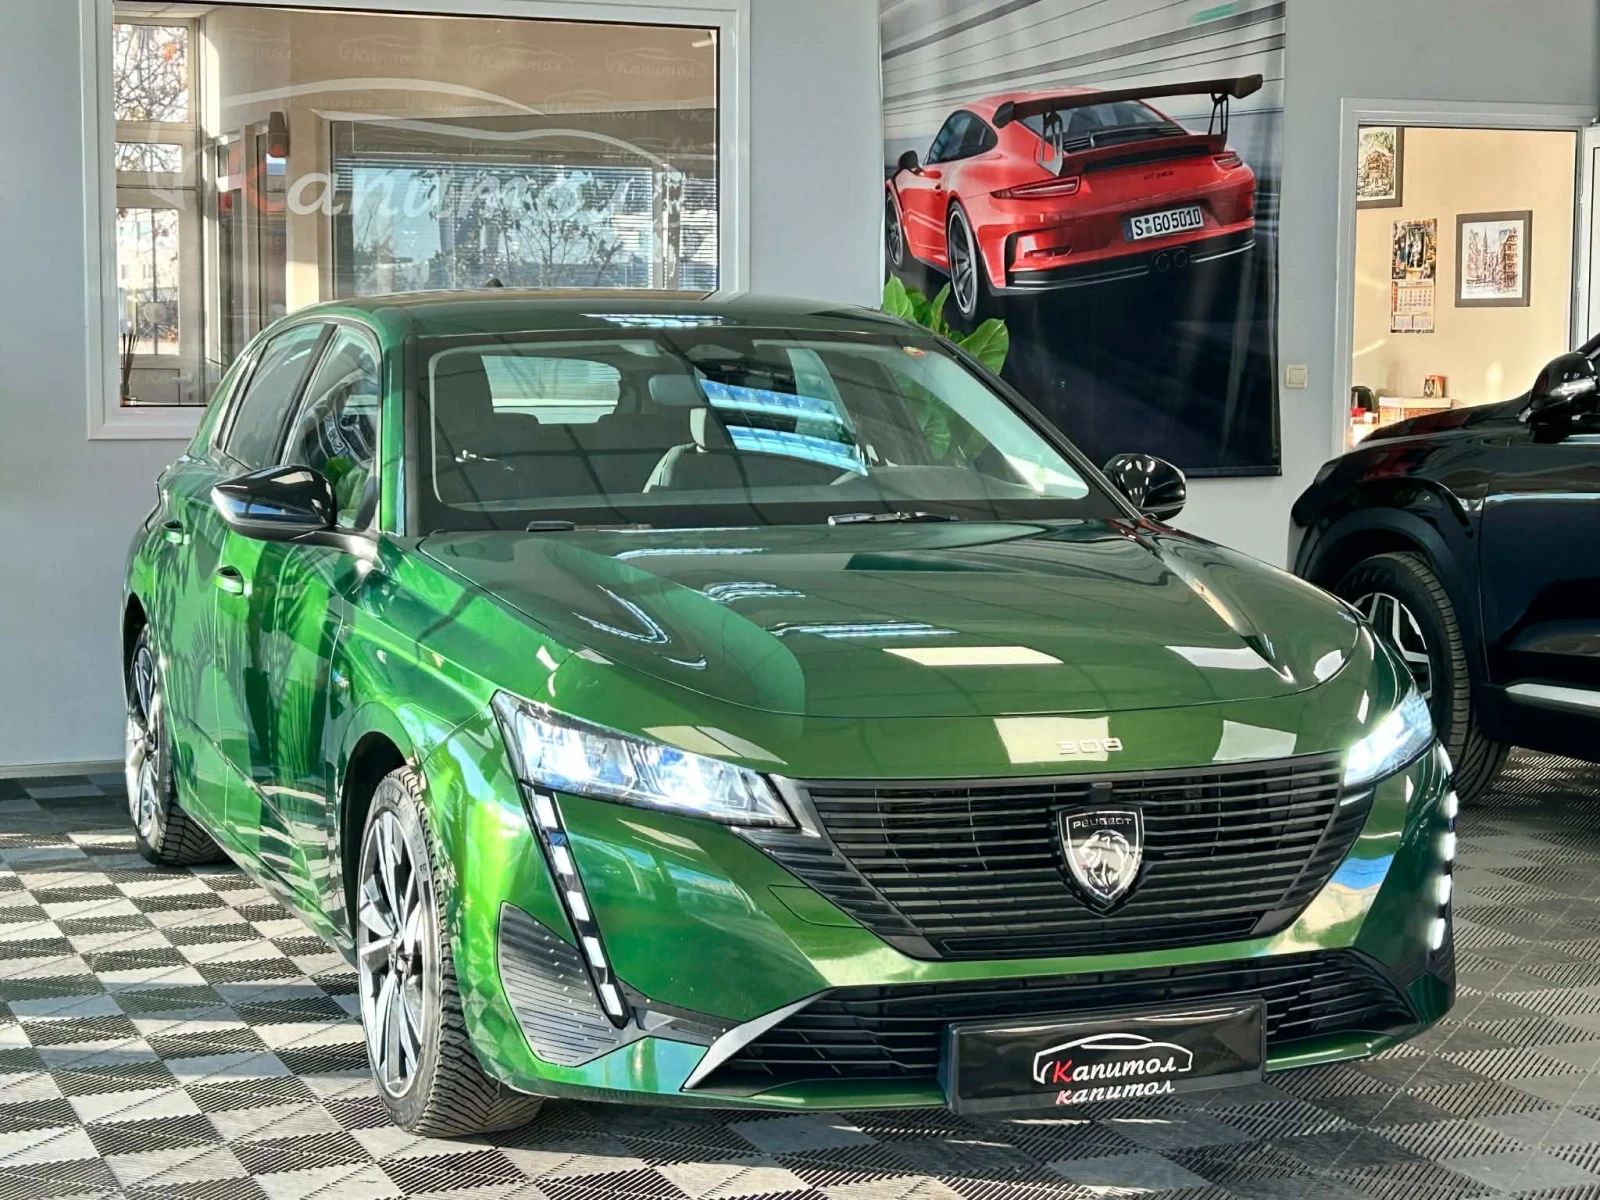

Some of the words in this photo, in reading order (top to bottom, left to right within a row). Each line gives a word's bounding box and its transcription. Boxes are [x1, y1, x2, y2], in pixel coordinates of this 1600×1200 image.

[1056, 737, 1123, 754] 308
[1072, 817, 1132, 829] PEUGEOT
[1052, 1056, 1177, 1083] Капитол
